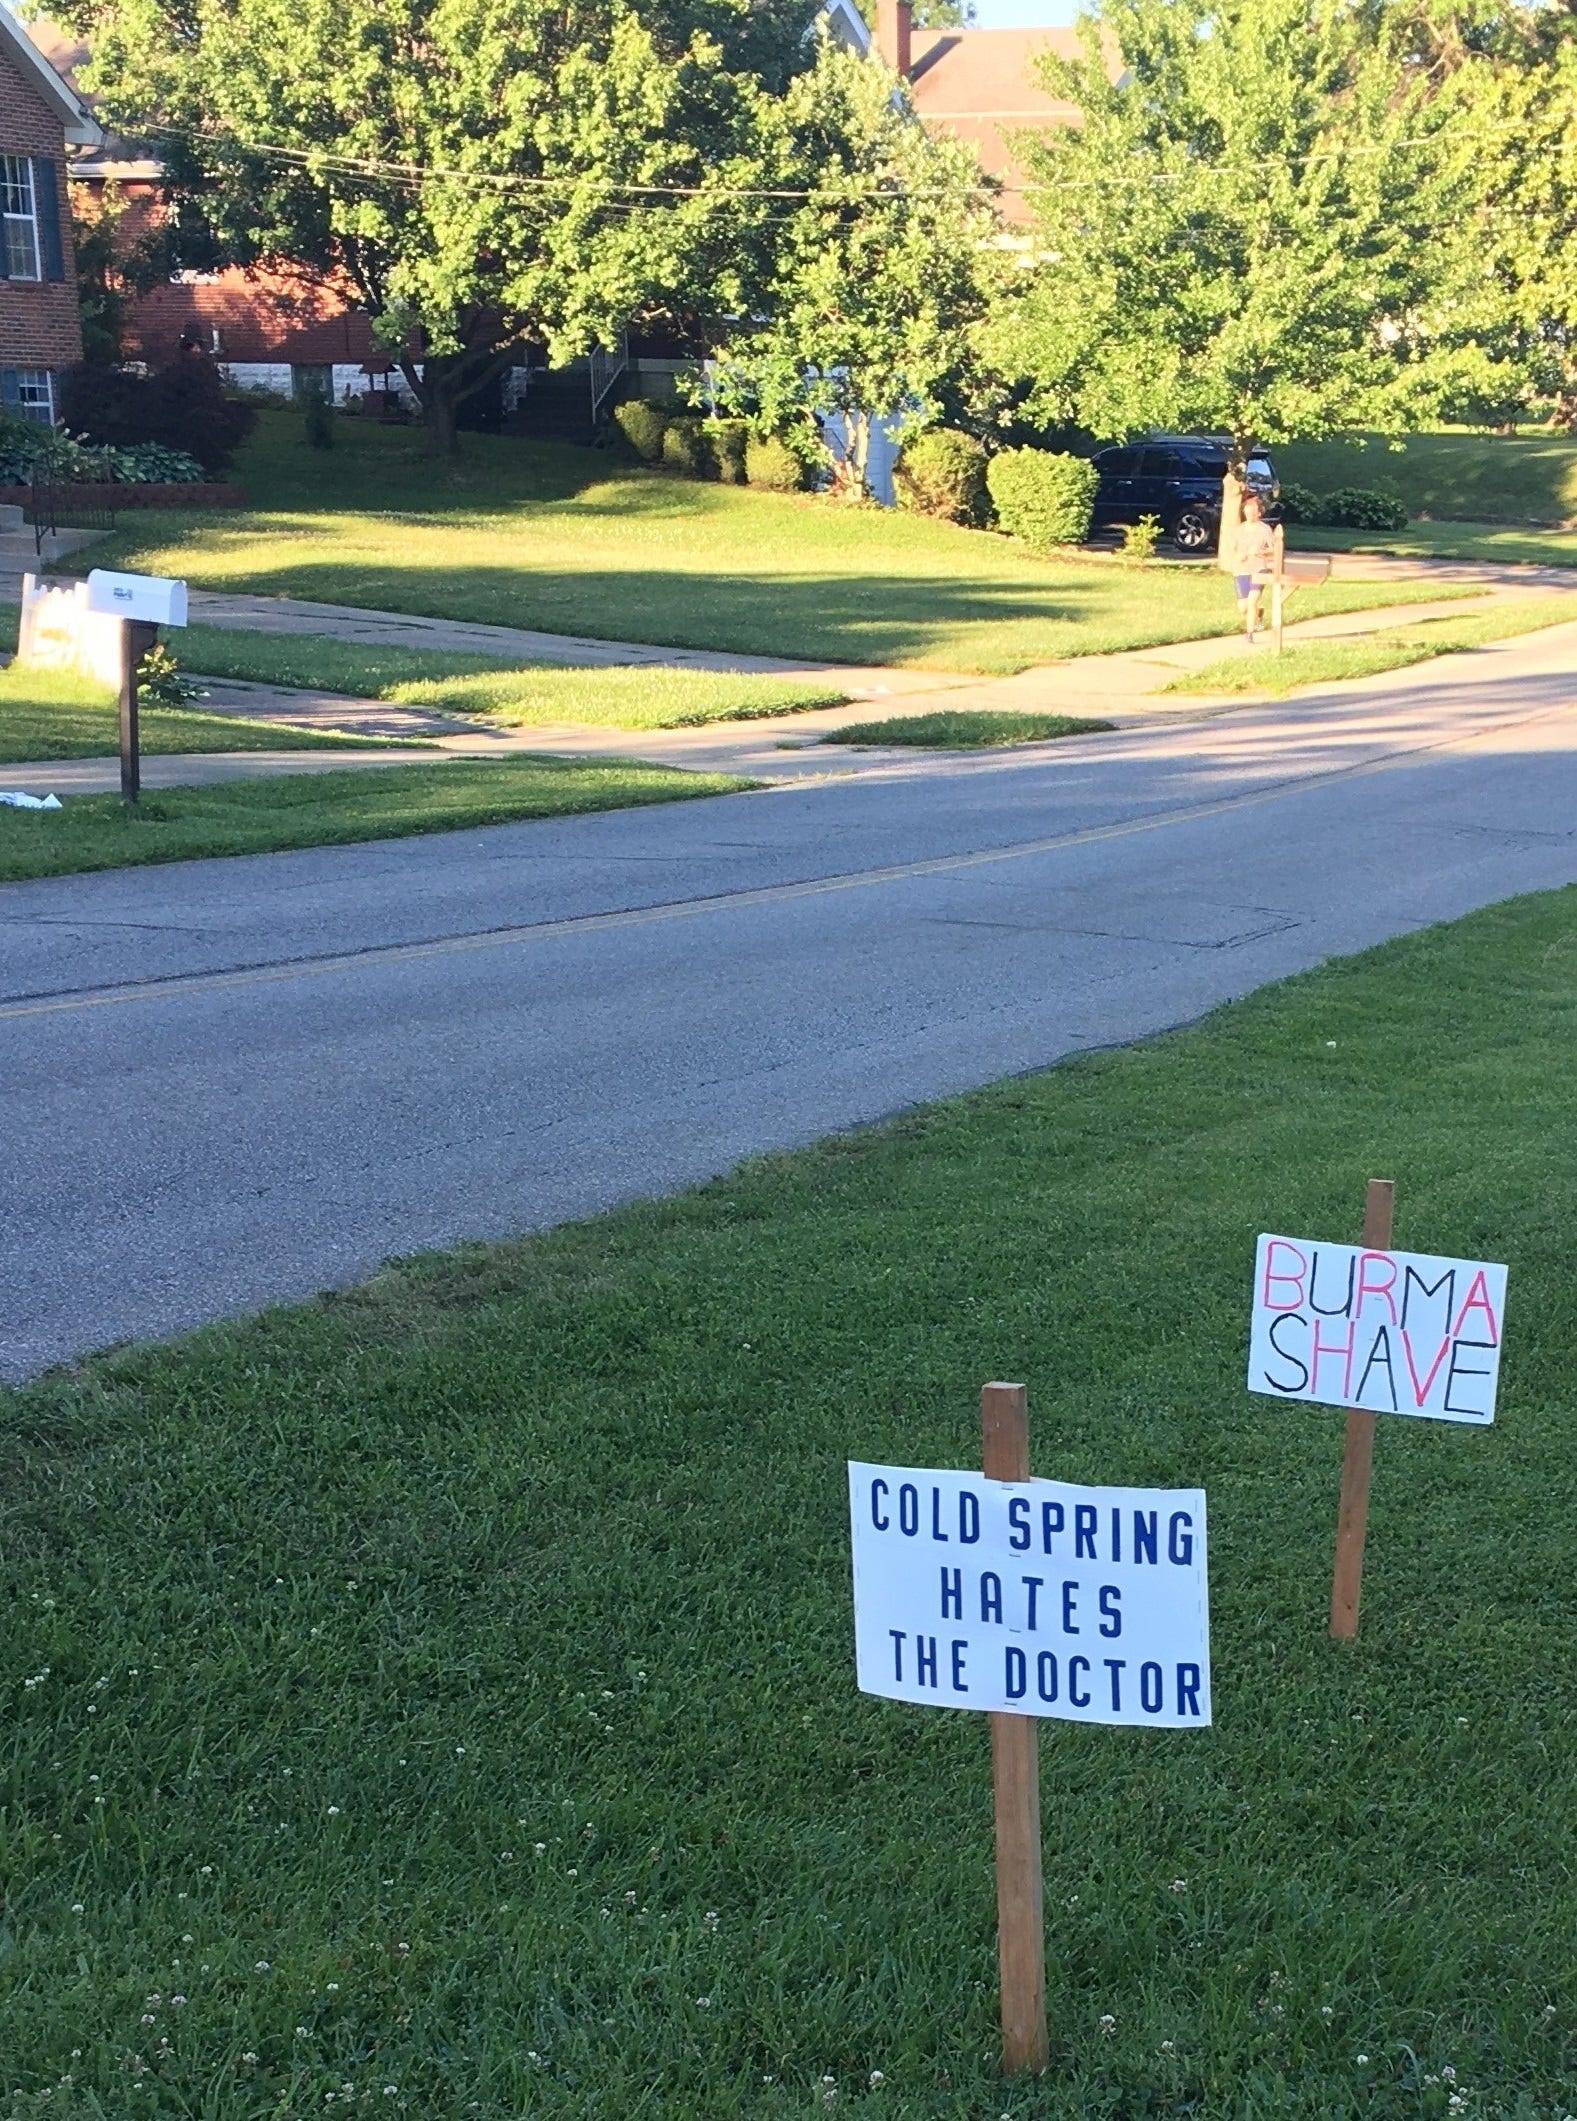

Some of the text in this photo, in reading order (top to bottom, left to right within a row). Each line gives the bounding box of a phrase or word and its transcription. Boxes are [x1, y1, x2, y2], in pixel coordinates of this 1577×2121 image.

[1264, 1241, 1498, 1348] BURMA
[1264, 1312, 1497, 1416] SHAVE
[871, 1478, 1194, 1566] COLD SPRING
[940, 1566, 1122, 1639] HATES
[889, 1629, 1201, 1716] THE DOCTOR
